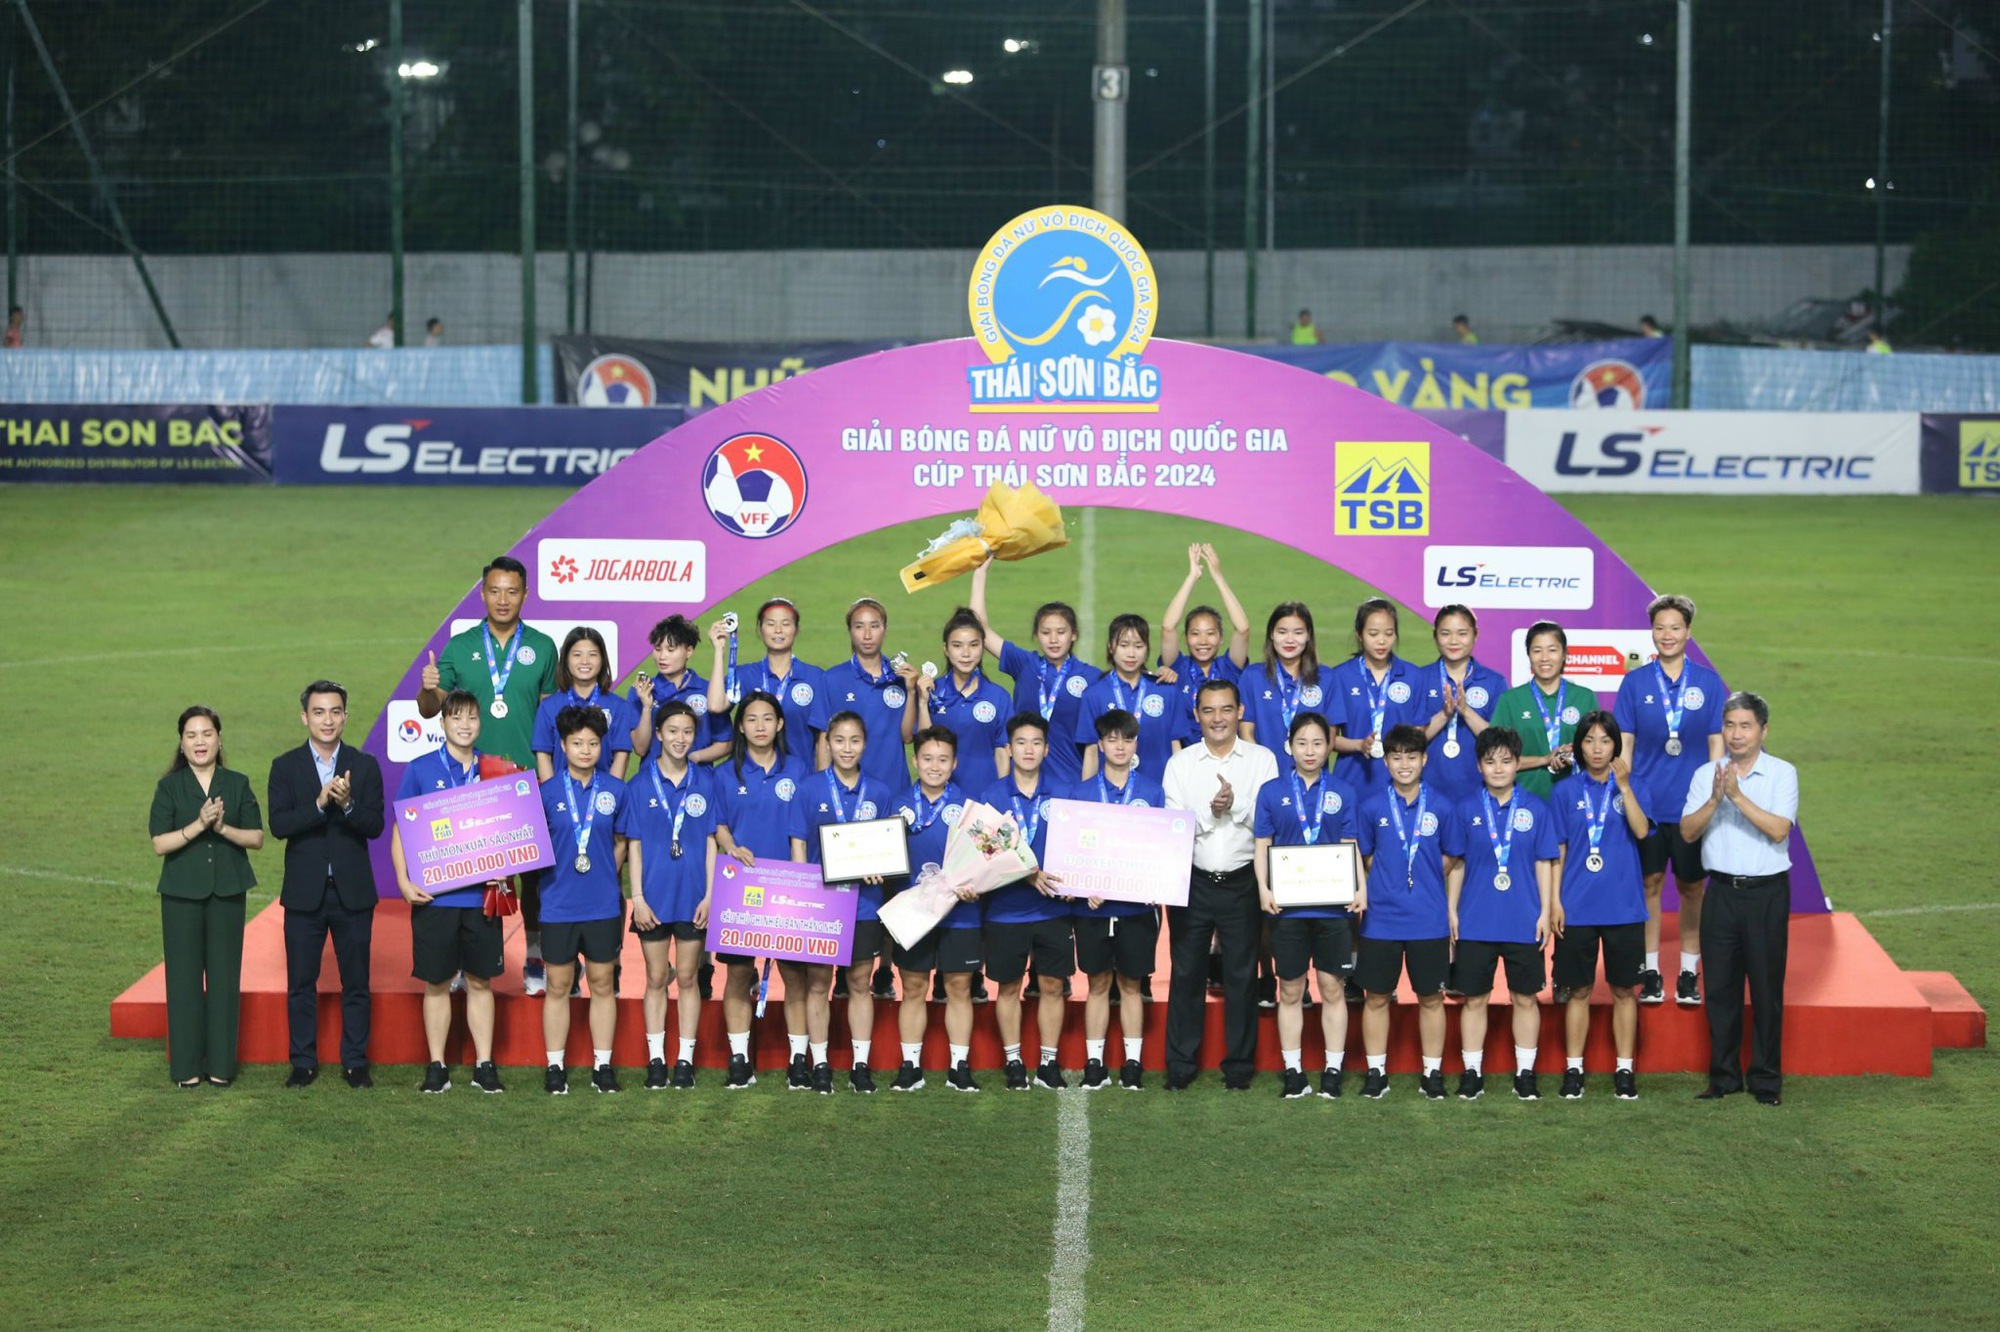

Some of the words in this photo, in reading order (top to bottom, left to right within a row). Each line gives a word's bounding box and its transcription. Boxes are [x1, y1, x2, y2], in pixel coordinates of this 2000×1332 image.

[1100, 67, 1120, 99] 3
[1136, 276, 1150, 303] GIA
[1129, 308, 1150, 343] 2024
[971, 357, 1031, 398] THÁI
[1039, 353, 1095, 397] SƠN
[1103, 355, 1157, 397] BẮC
[1371, 357, 1532, 410] VÀNG
[0, 419, 70, 446] HAI
[81, 419, 157, 446] SON
[168, 419, 243, 446] BAC
[320, 423, 412, 473] LS
[841, 418, 893, 451] GIẢI
[900, 424, 970, 452] BÓNG
[976, 424, 1012, 452] ĐÁ
[1019, 423, 1058, 452] NỮ
[1062, 424, 1095, 452] VÔ
[1101, 428, 1162, 456] ĐỊCH
[1169, 420, 1238, 454] QUỐC
[1245, 428, 1288, 452] GIA
[913, 459, 965, 488] CÚP
[971, 459, 1028, 488] THÁI
[1035, 462, 1088, 488] SƠN
[1096, 455, 1147, 488] BẮC
[1154, 464, 1216, 488] 2024
[1554, 431, 1644, 478] LS
[1648, 449, 1875, 480] ELECTRIC
[740, 512, 770, 525] VFF
[1340, 500, 1423, 530] TSB
[583, 558, 694, 582] JOGARBOLA
[1437, 566, 1477, 587] LS
[1479, 574, 1580, 589] ELECTRIC
[423, 852, 506, 885] 20.000.000
[720, 928, 804, 953] 20.000.000
